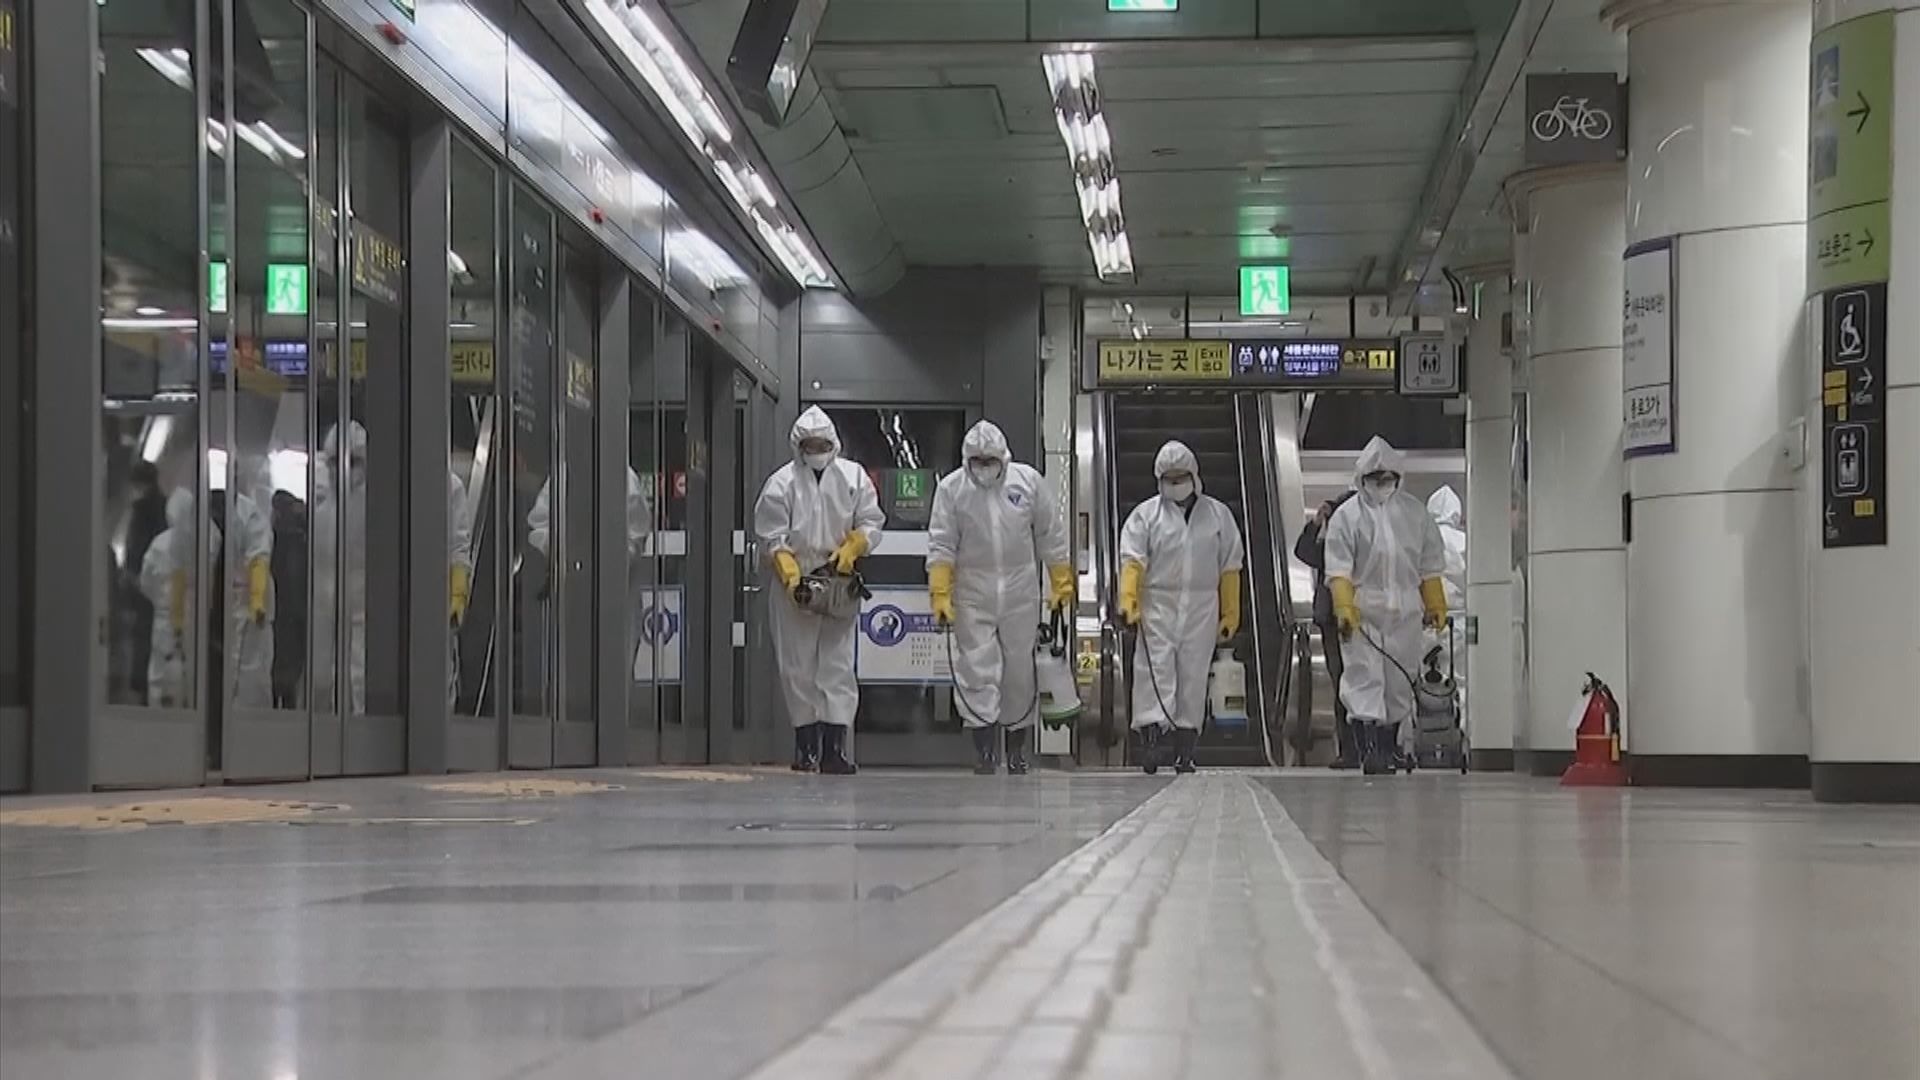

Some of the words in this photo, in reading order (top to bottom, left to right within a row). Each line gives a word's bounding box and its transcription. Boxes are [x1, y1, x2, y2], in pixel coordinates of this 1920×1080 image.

[1107, 349, 1163, 371] 나가는
[1171, 349, 1188, 371] 곳
[1201, 348, 1223, 359] Exit
